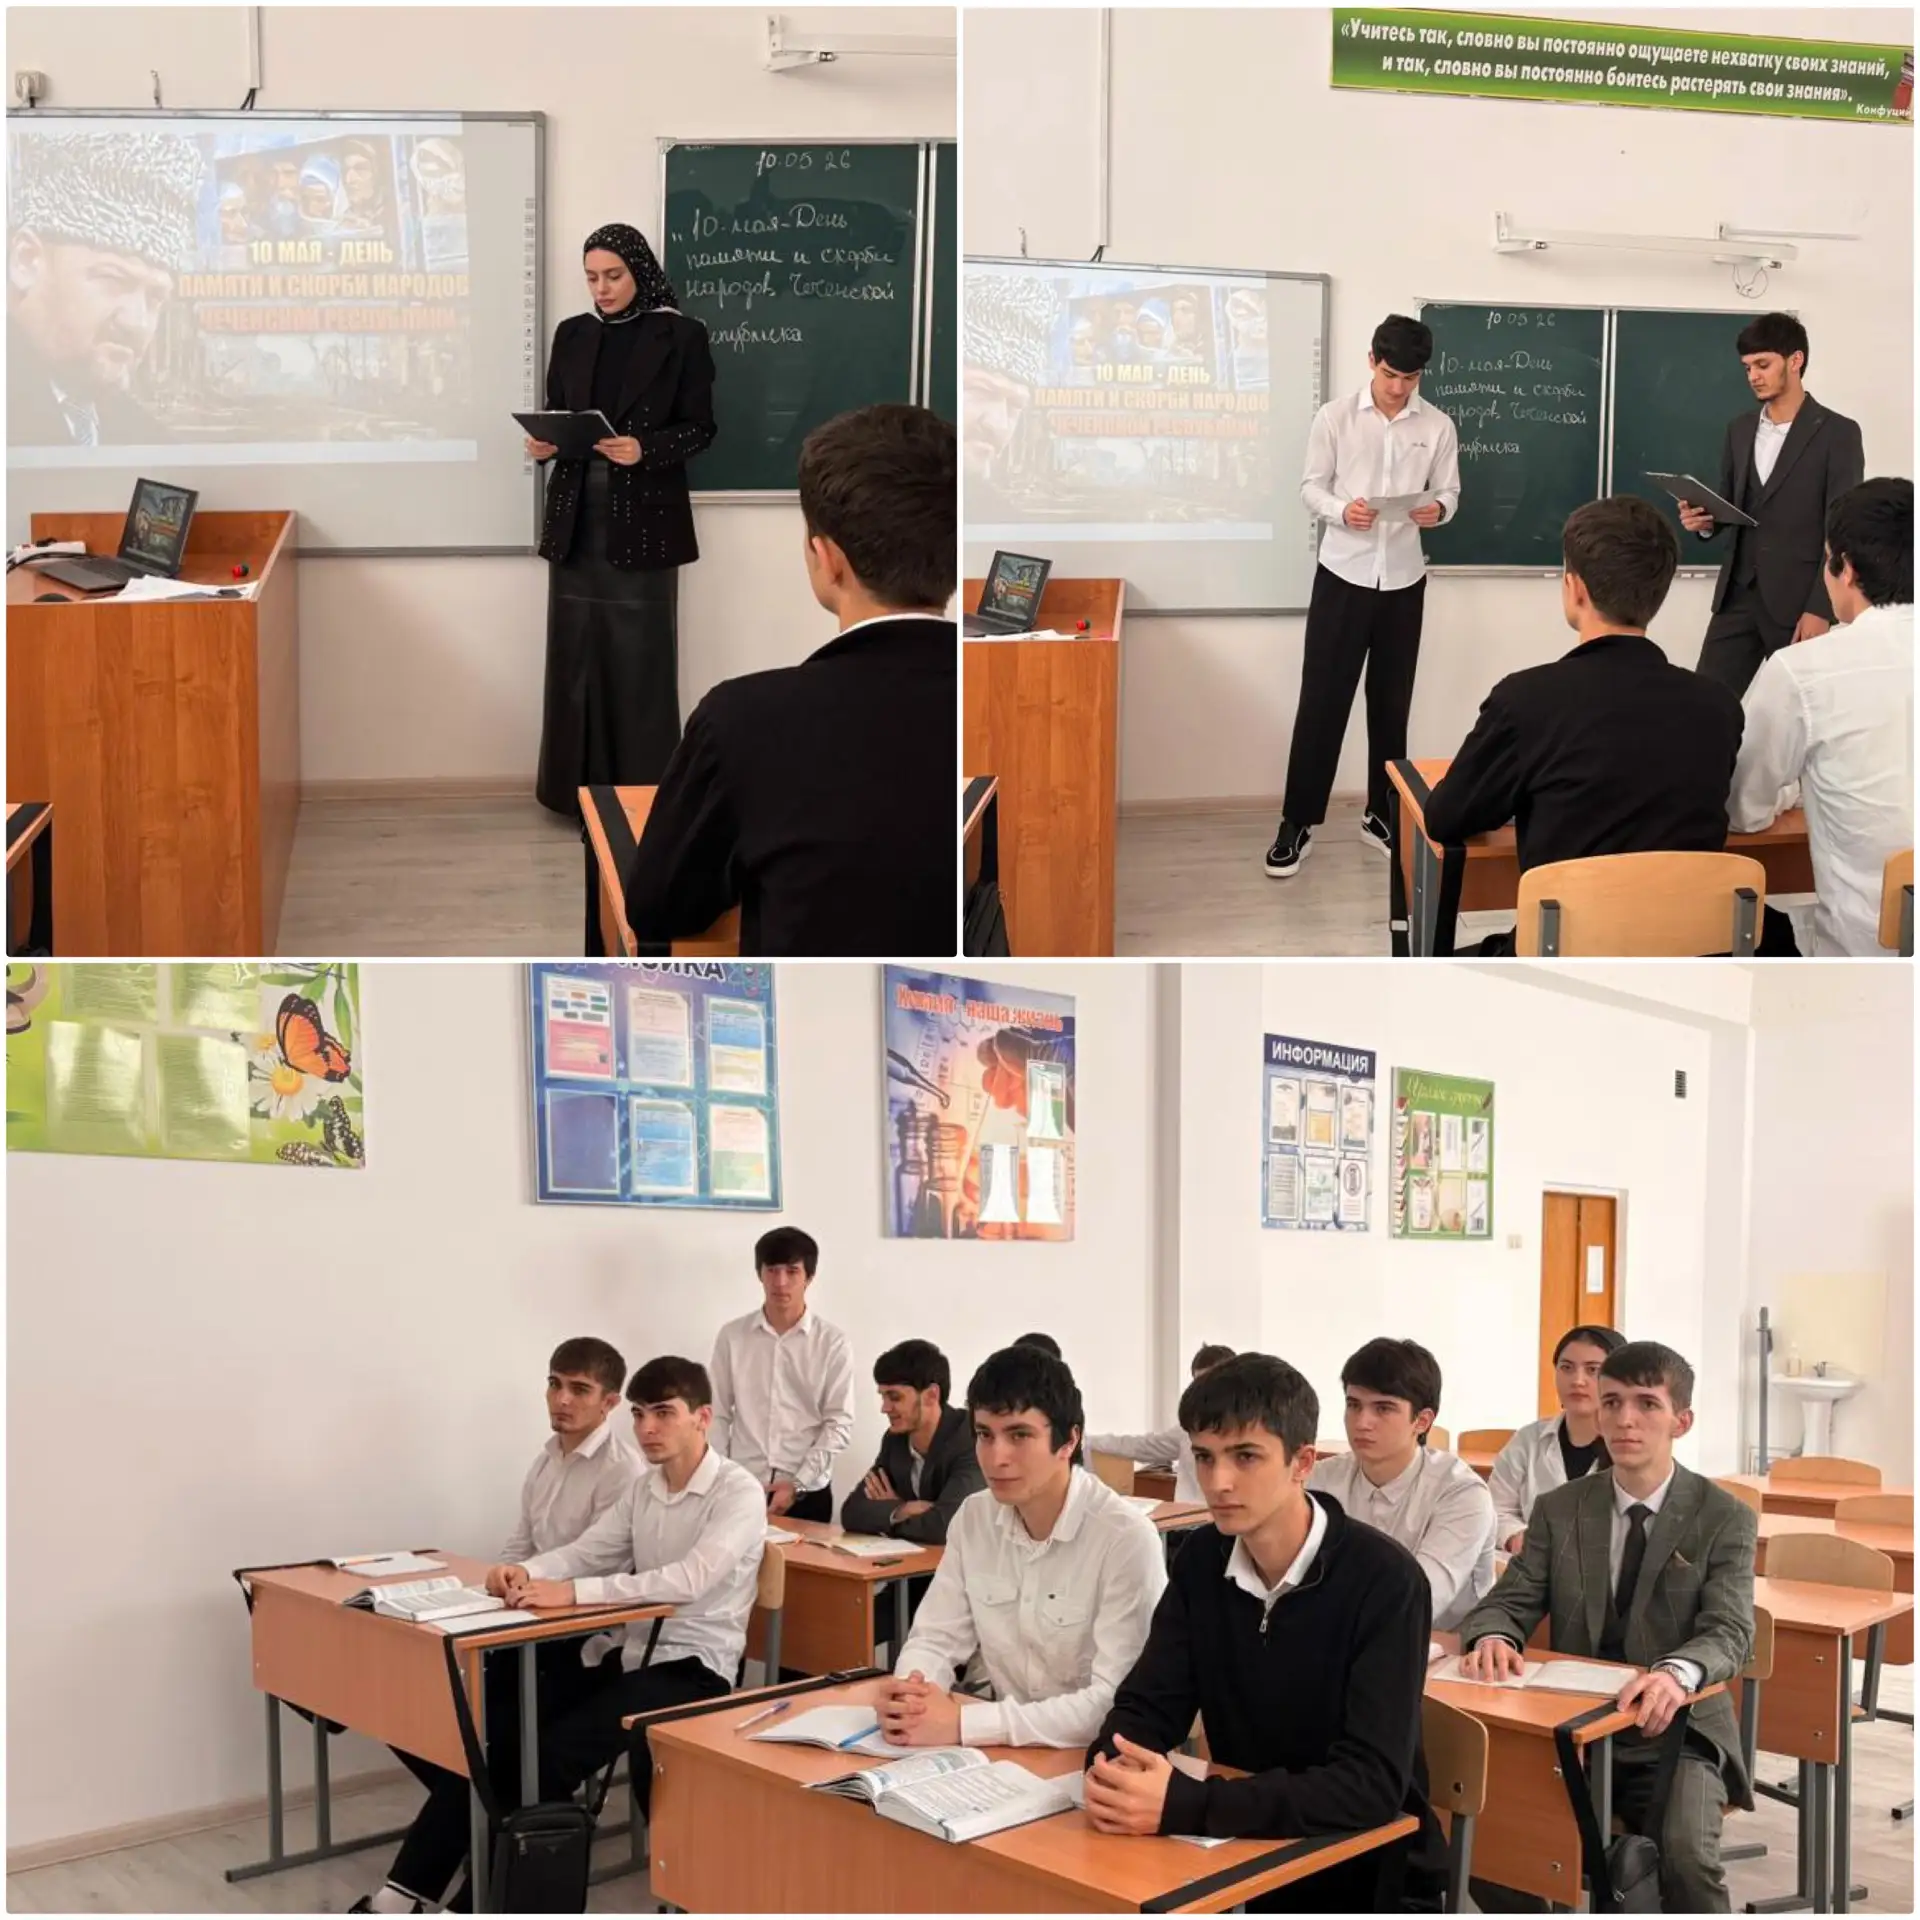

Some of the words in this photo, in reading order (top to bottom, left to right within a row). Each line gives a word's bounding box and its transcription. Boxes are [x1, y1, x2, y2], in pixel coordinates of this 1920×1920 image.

[1341, 18, 1415, 43] «Учитесь
[1419, 27, 1453, 48] так,
[1457, 29, 1514, 51] словно
[1517, 35, 1540, 51] вы
[1543, 36, 1625, 58] постоянно
[1628, 43, 1707, 66] ощущаете
[1711, 51, 1783, 74] нехватку
[1785, 56, 1827, 73] своих
[1830, 58, 1891, 80] знаний,
[1383, 56, 1393, 71] и
[1396, 56, 1431, 77] так,
[1434, 57, 1492, 78] словно
[1495, 62, 1518, 80] вы
[1520, 64, 1604, 86] постоянно
[1607, 66, 1667, 89] боитесь
[1670, 75, 1747, 99] растерять
[1749, 81, 1783, 97] свои
[1786, 82, 1853, 103] знания».
[250, 240, 271, 264] 10
[278, 240, 322, 264] МАЯ
[339, 240, 394, 267] ДЕНЬ
[178, 273, 264, 298] ПАМЯТИ
[268, 274, 282, 298] И
[1096, 364, 1113, 382] 10
[1117, 364, 1153, 383] МАЯ
[1166, 365, 1211, 386] ДЕНЬ
[1034, 388, 1105, 409] ПАМЯТИ
[1108, 388, 1120, 409] И
[1123, 390, 1190, 411] СКОРБИ
[1272, 1040, 1369, 1075] ИНФОРМАЦИЯ
